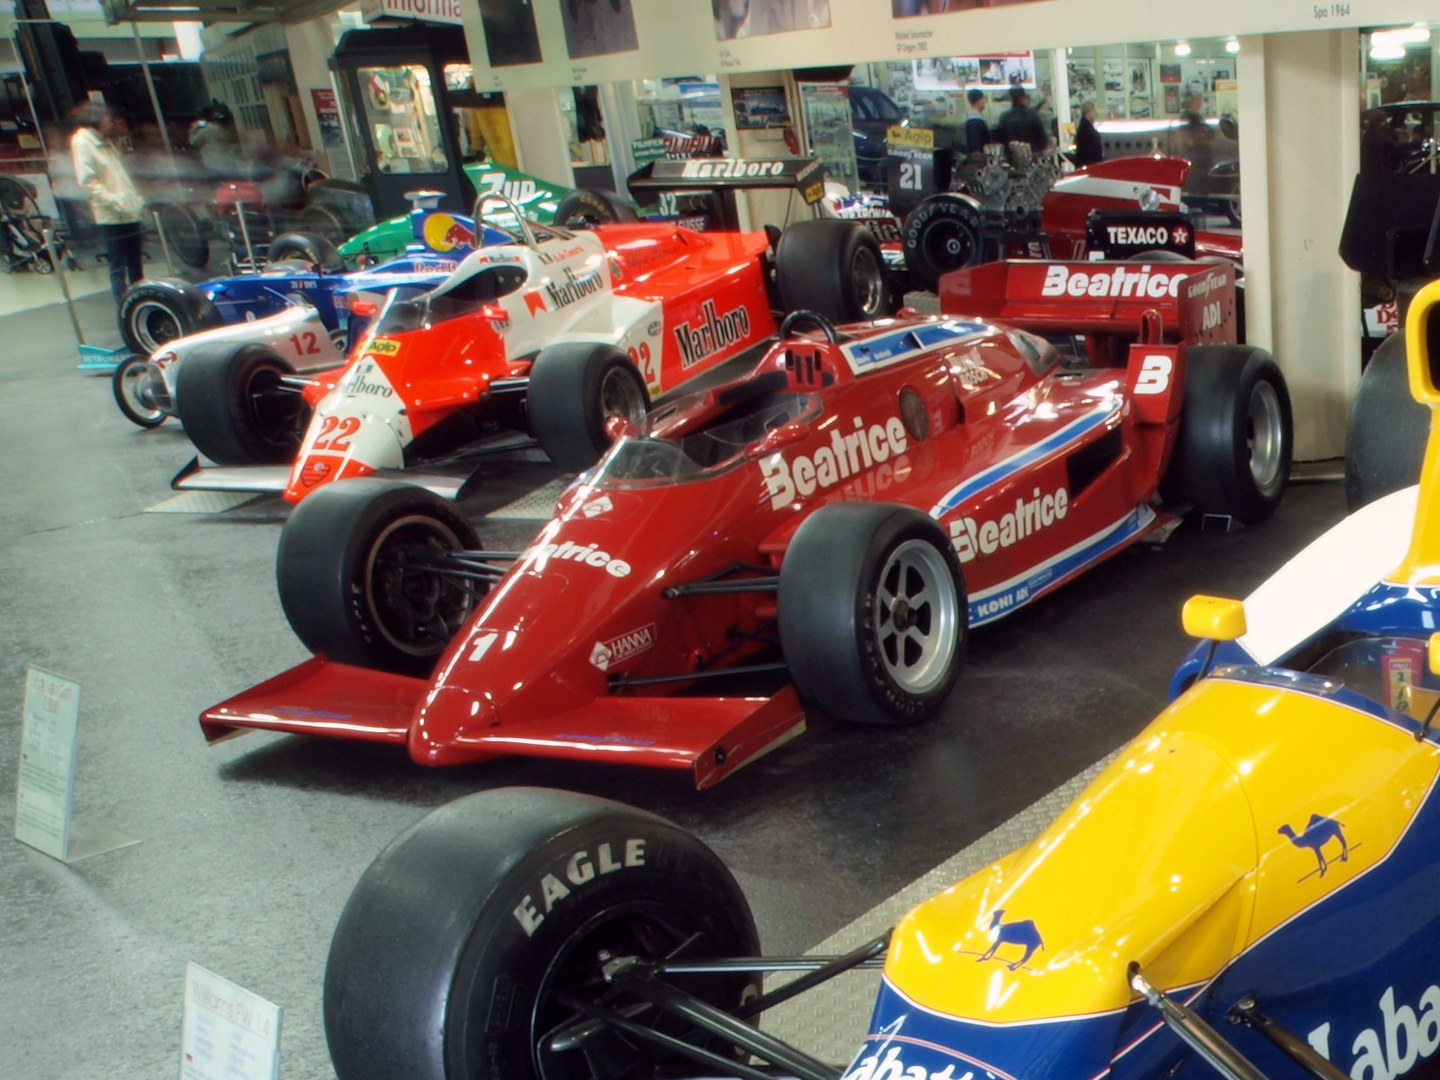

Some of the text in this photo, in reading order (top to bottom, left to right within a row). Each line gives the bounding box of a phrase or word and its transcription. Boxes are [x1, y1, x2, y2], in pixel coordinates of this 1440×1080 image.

[1313, 4, 1350, 19] Spa 1964
[680, 160, 784, 179] Marlboro
[899, 163, 923, 190] 21
[1107, 227, 1168, 245] TEXACO
[546, 266, 604, 313] Marlboro
[1202, 300, 1222, 331] ADI
[290, 331, 321, 356] 12
[674, 298, 749, 370] Marlboro
[1133, 354, 1173, 395] B
[312, 415, 362, 451] 22
[758, 415, 909, 511] Beatrice
[948, 486, 1069, 564] Beatrice
[977, 593, 1013, 618] KONI
[468, 633, 499, 662] 1
[610, 628, 651, 653] HANNA
[513, 838, 647, 938] EAGLE
